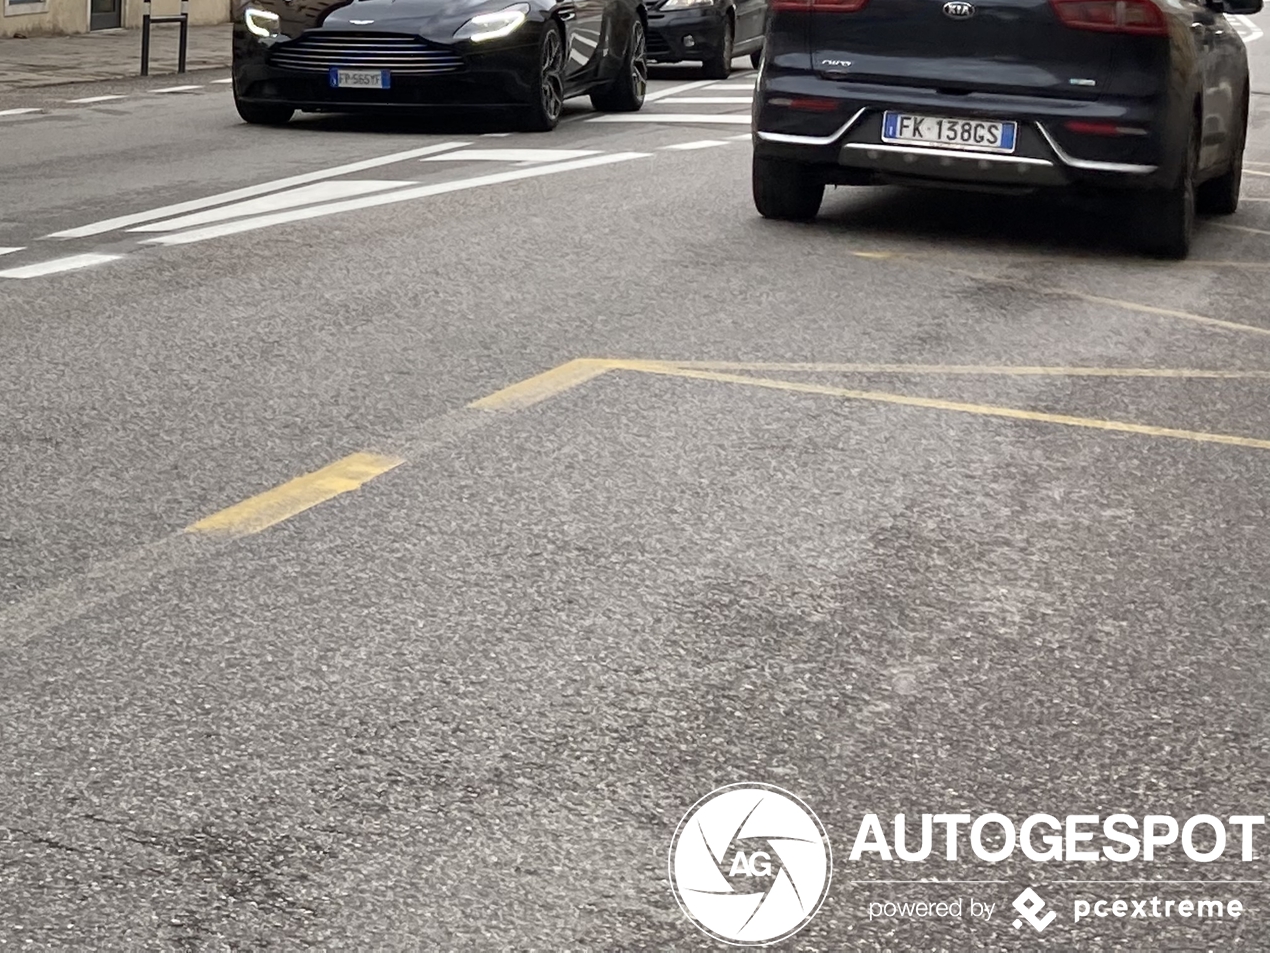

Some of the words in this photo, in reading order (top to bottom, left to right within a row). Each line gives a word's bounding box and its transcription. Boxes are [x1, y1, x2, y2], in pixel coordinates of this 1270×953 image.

[947, 4, 970, 15] KIA
[899, 116, 925, 138] FK
[936, 119, 1000, 144] 138GS
